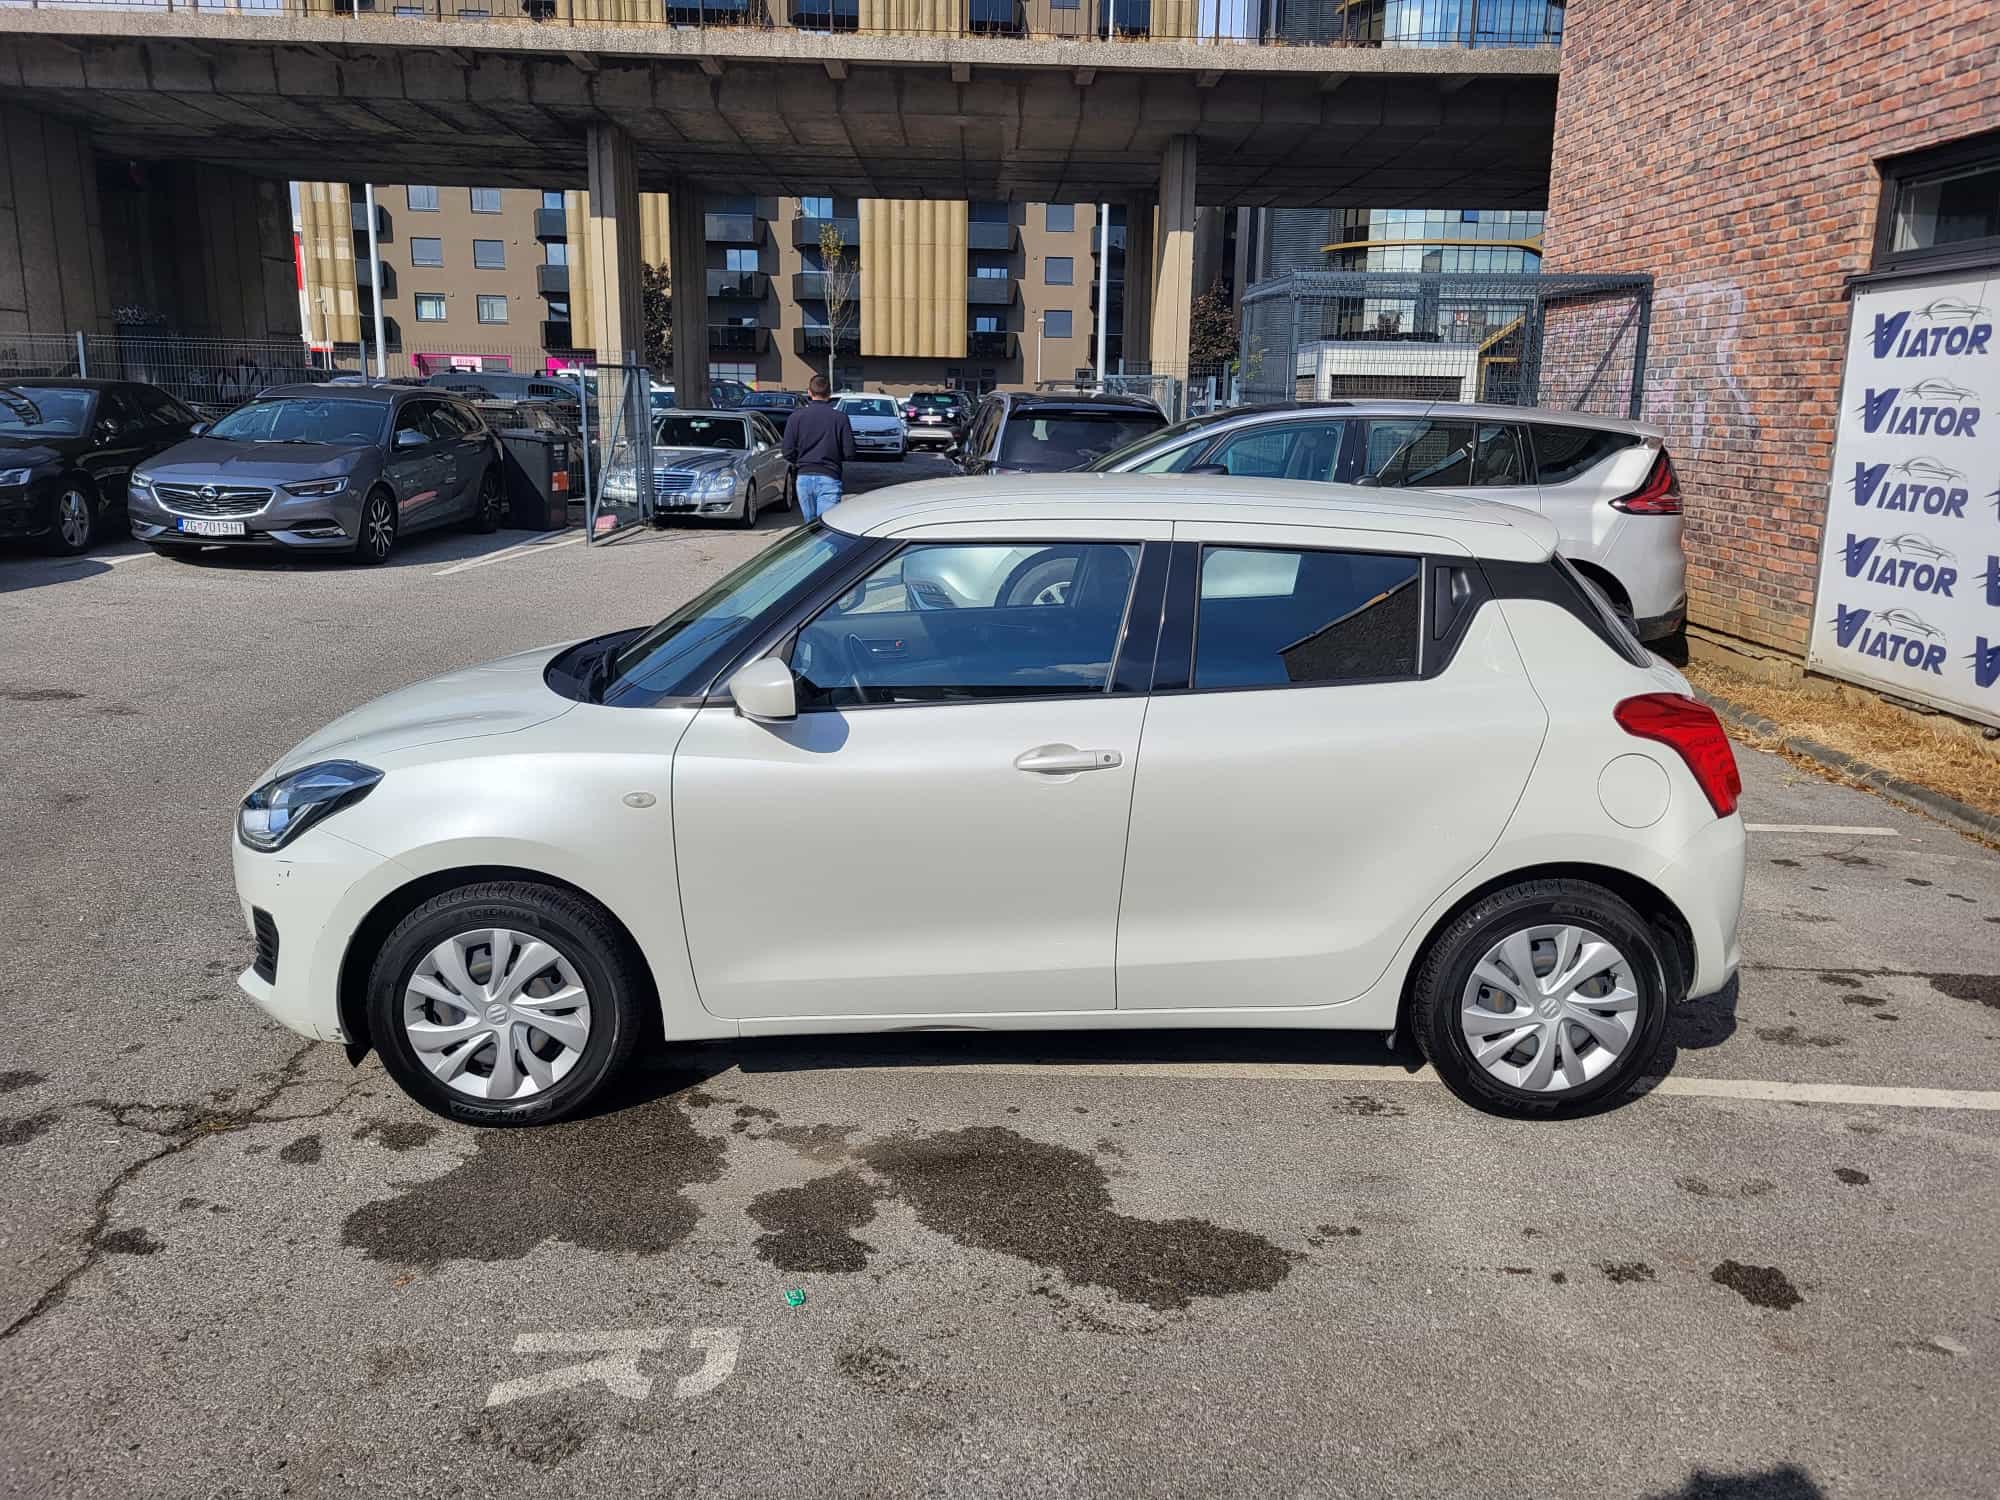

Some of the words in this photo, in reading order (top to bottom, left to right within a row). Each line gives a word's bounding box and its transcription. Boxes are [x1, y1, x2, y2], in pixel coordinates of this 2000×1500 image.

[1872, 309, 1993, 360] VIATOR
[1863, 387, 1981, 438] VIATOR
[1853, 461, 1969, 519] VIATOR
[1844, 532, 1958, 598] VIATOR
[1836, 603, 1947, 676] VIATOR
